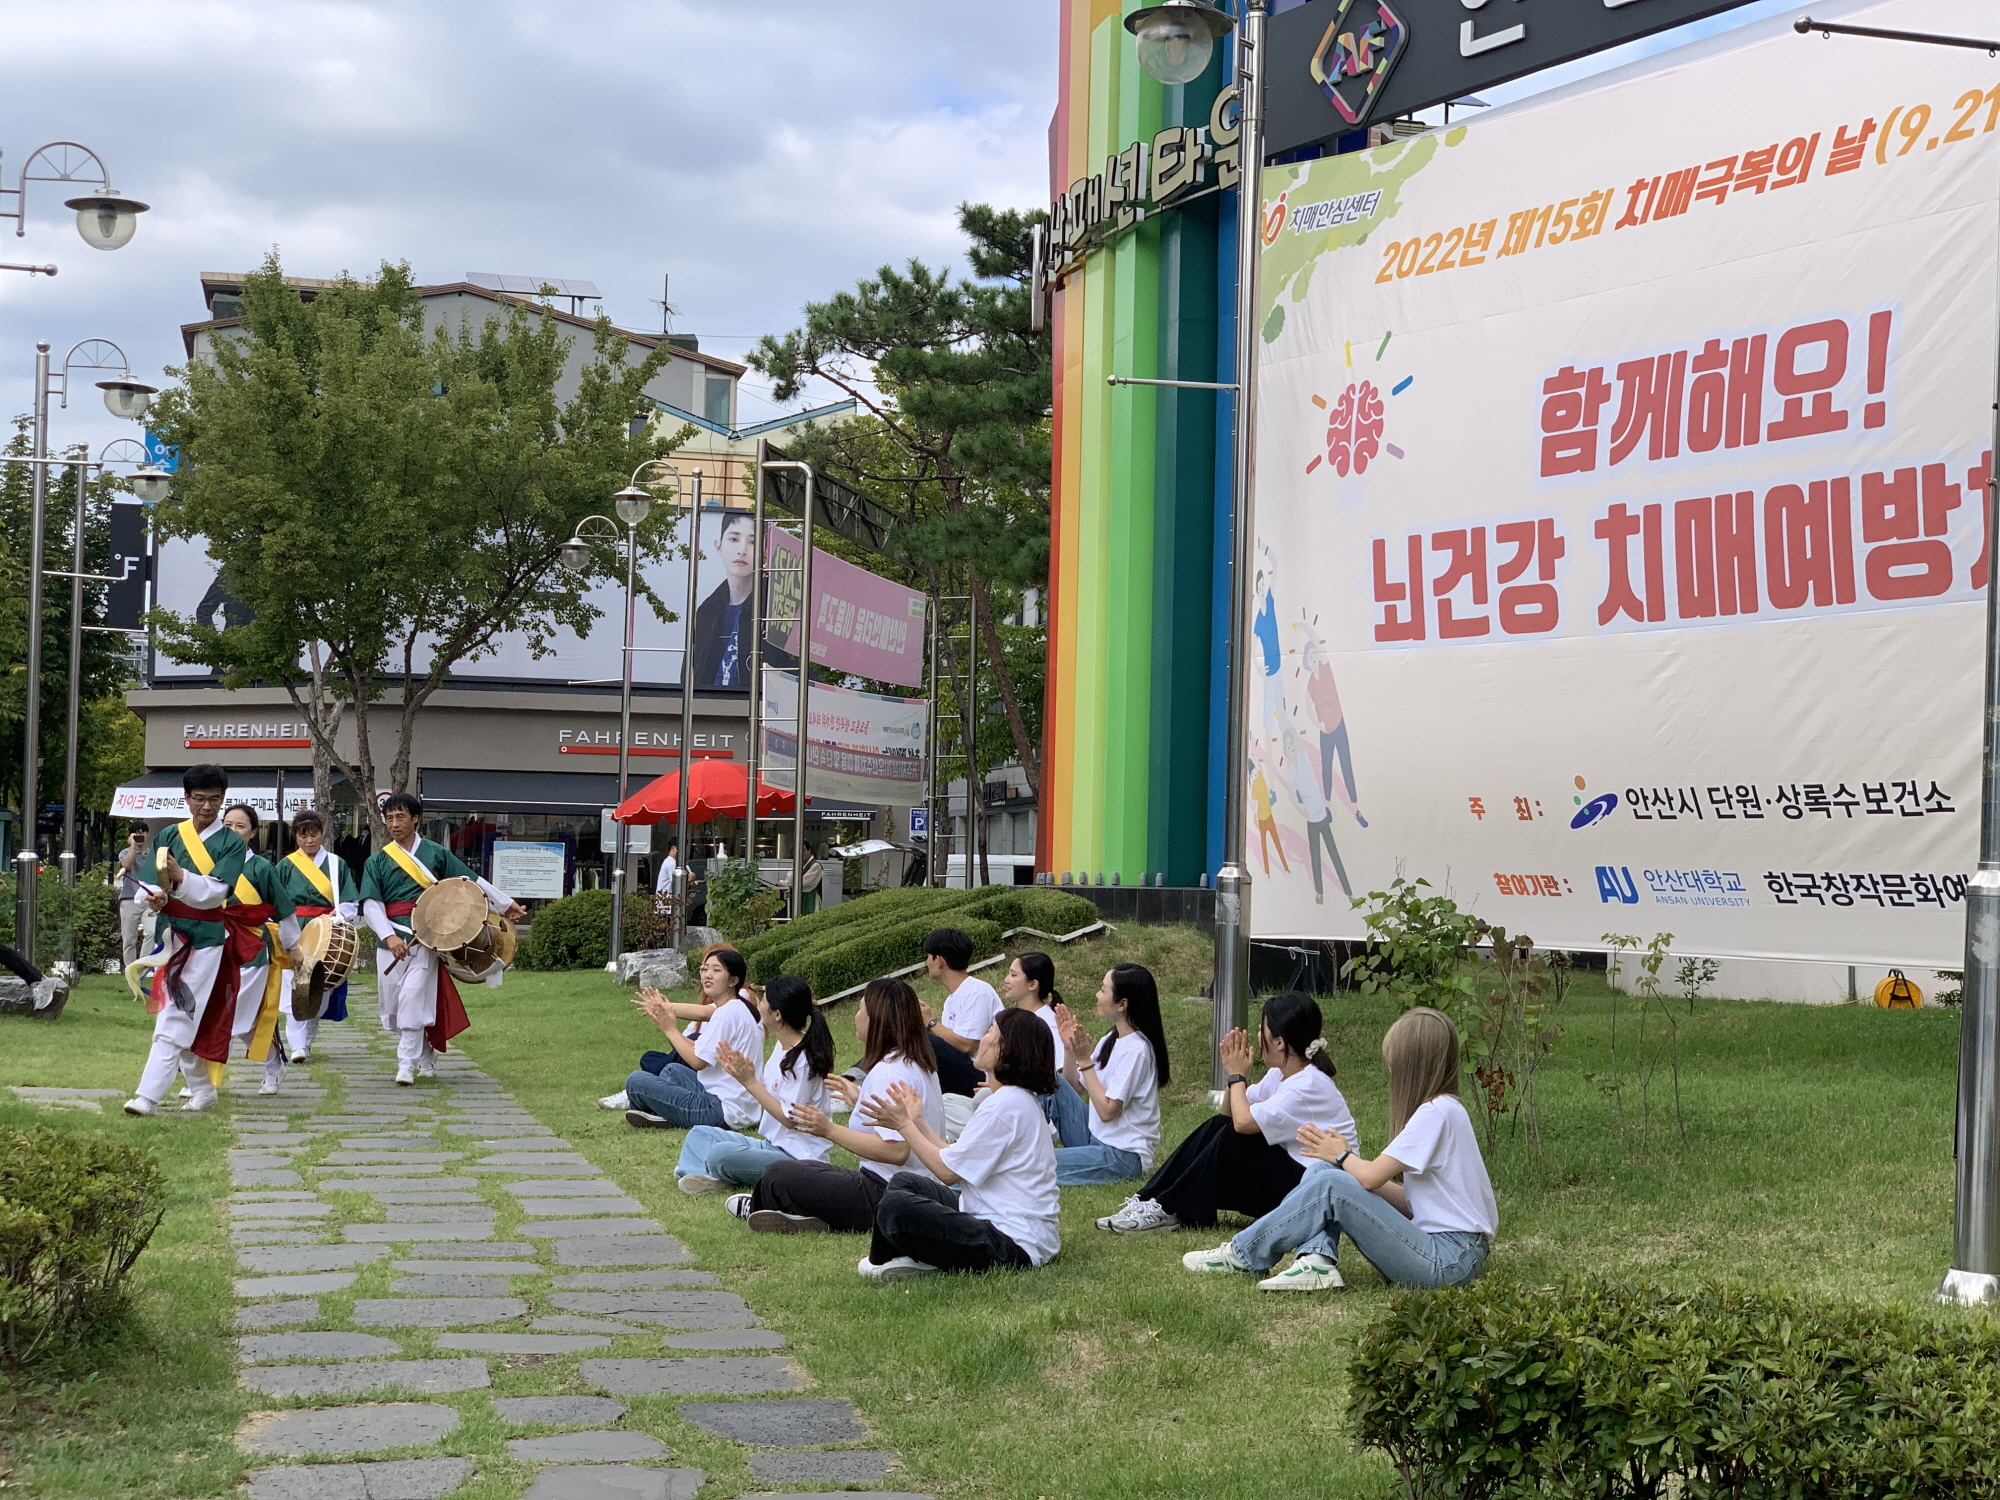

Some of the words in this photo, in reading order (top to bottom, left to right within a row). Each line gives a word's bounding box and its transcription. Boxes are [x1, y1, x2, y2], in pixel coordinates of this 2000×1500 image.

[1328, 19, 1386, 84] AF
[1289, 191, 1382, 233] 치매안심센터
[1375, 220, 1498, 285] 2022년
[1496, 188, 1615, 260] 제15회
[1614, 132, 1822, 231] 치매극복의
[1540, 310, 1893, 478] 함께해요!
[1372, 518, 1565, 642] 뇌건강
[183, 724, 309, 738] FAHRENHEIT
[116, 794, 147, 809] 지이크
[147, 797, 186, 810] 파렌하이트
[1468, 797, 1486, 820] 주
[1625, 786, 1704, 820] 안산시
[915, 817, 925, 830] P
[1595, 866, 1639, 904] AU
[1643, 869, 1747, 893] 안산대학교
[1655, 895, 1689, 905] ANSAN
[1691, 896, 1751, 907] UNIVERSITY
